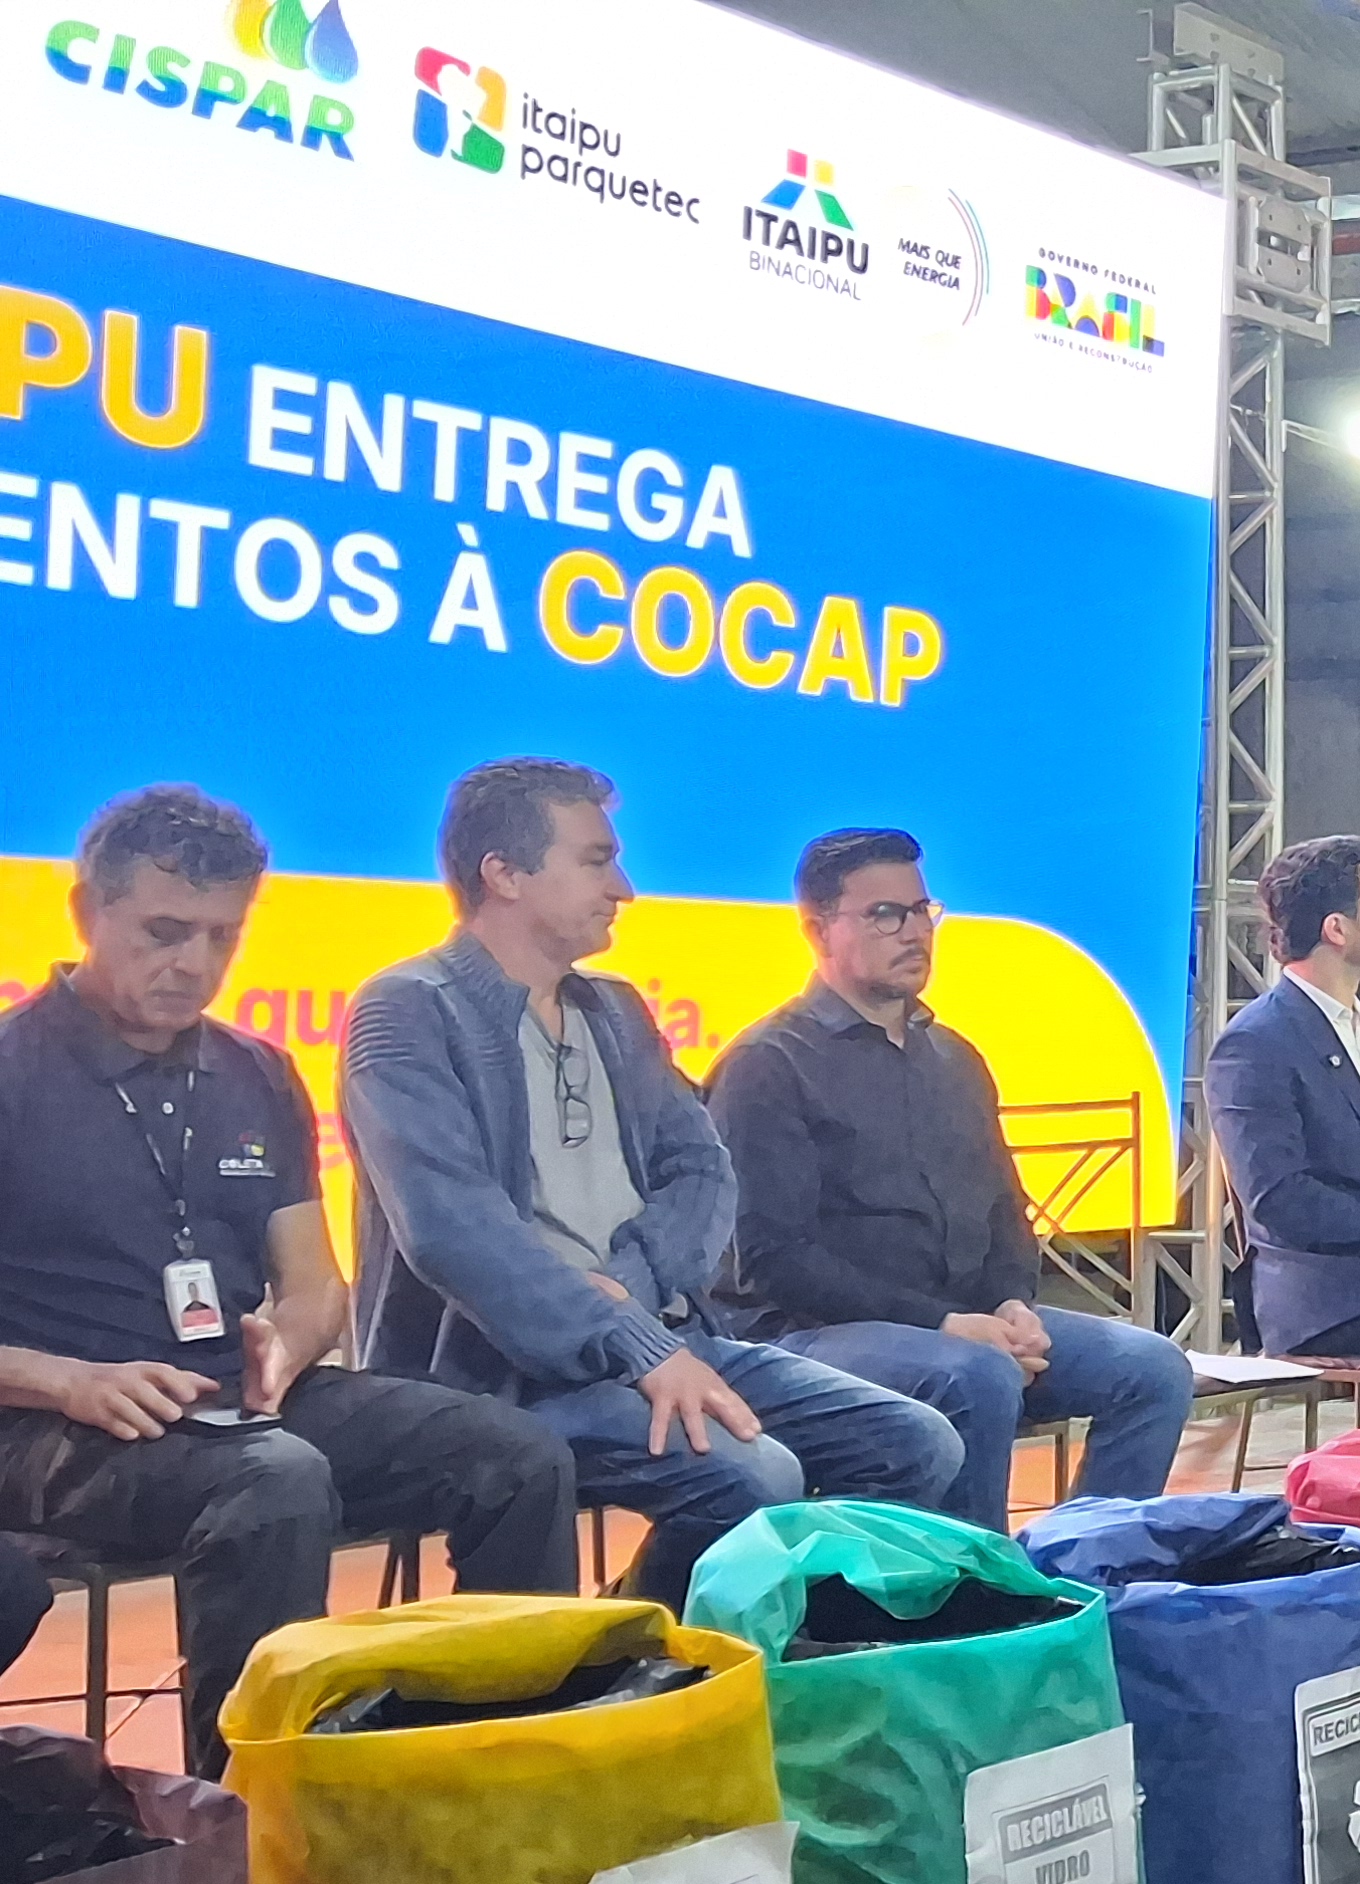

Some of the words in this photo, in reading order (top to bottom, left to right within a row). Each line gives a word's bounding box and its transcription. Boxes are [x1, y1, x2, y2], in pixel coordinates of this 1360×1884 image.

[45, 20, 355, 161] CISPAR
[522, 92, 621, 158] itaipu
[520, 143, 700, 224] parquetec
[742, 206, 869, 275] ITAIPU
[898, 238, 931, 260] MAIS
[935, 250, 962, 270] QUE
[1038, 247, 1099, 275] GOVERNO
[1104, 269, 1157, 295] FEDERAL
[750, 250, 861, 301] BINACIONAL
[903, 261, 960, 290] ENERGIA
[1025, 264, 1165, 357] BRASIL
[248, 363, 753, 560] ENTREGA
[427, 523, 509, 654] À
[538, 548, 944, 708] COCAP
